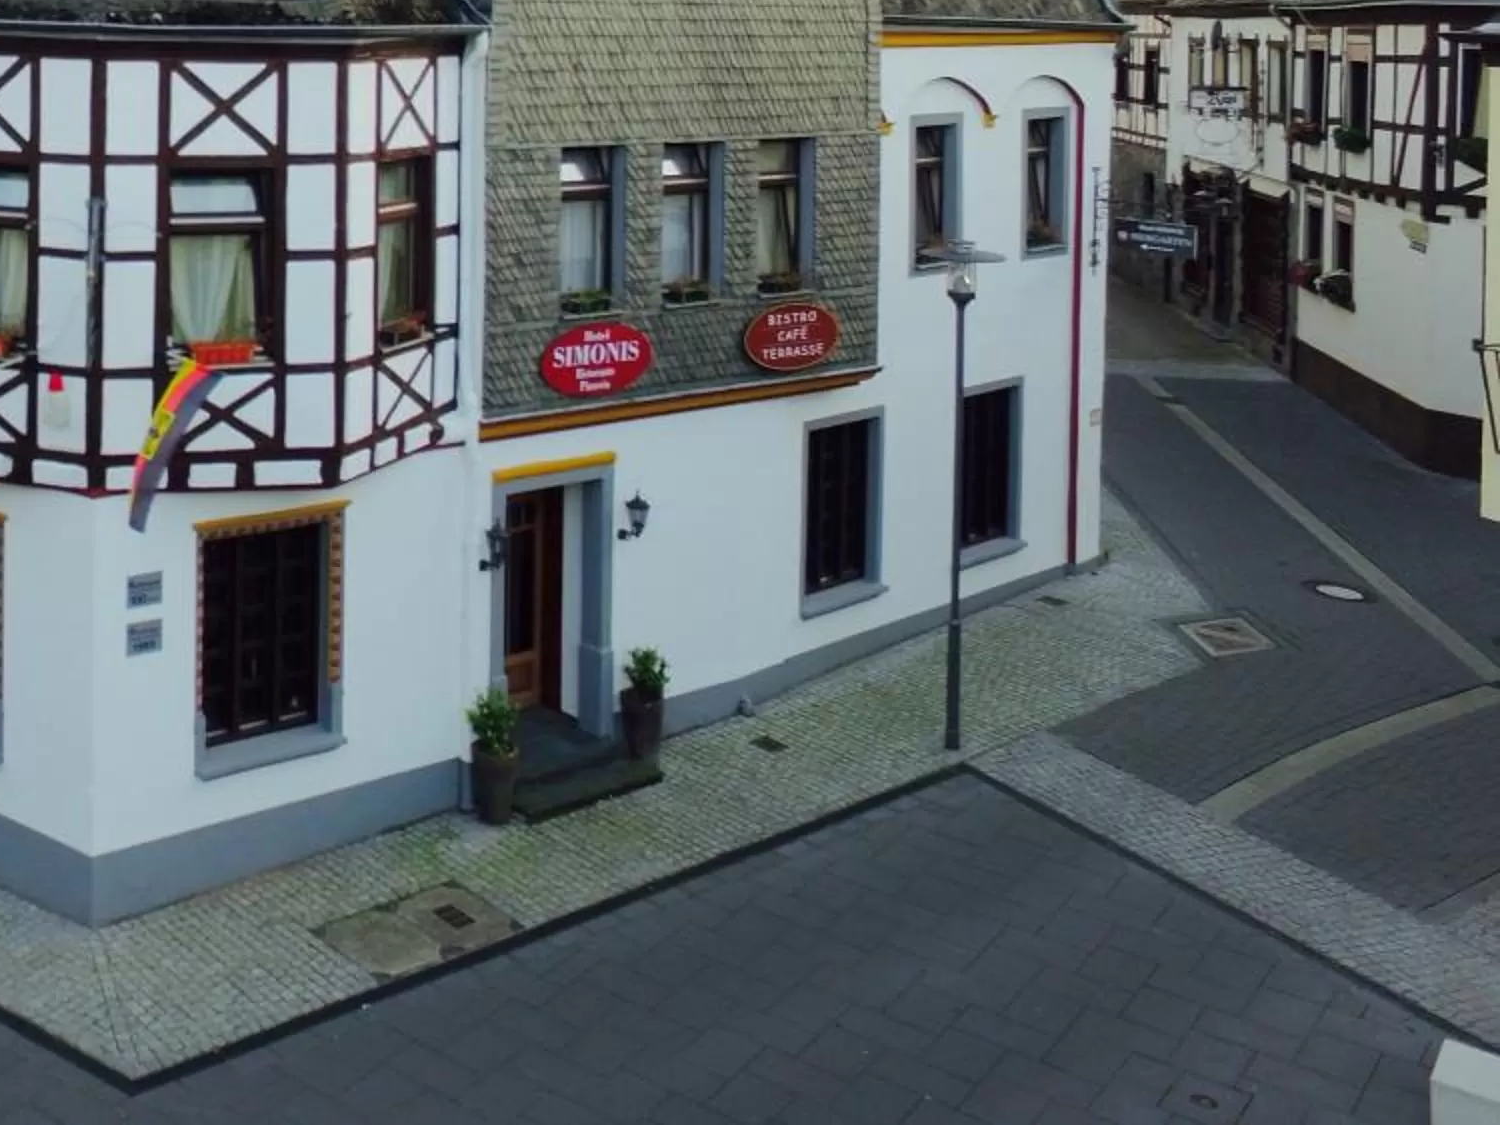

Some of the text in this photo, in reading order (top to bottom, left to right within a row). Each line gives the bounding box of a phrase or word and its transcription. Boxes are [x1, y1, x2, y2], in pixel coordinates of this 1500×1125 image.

[767, 310, 818, 327] BISTRO
[777, 324, 810, 342] CAFÉ
[552, 339, 641, 368] SIMONIS
[762, 342, 825, 360] TERRASSE
